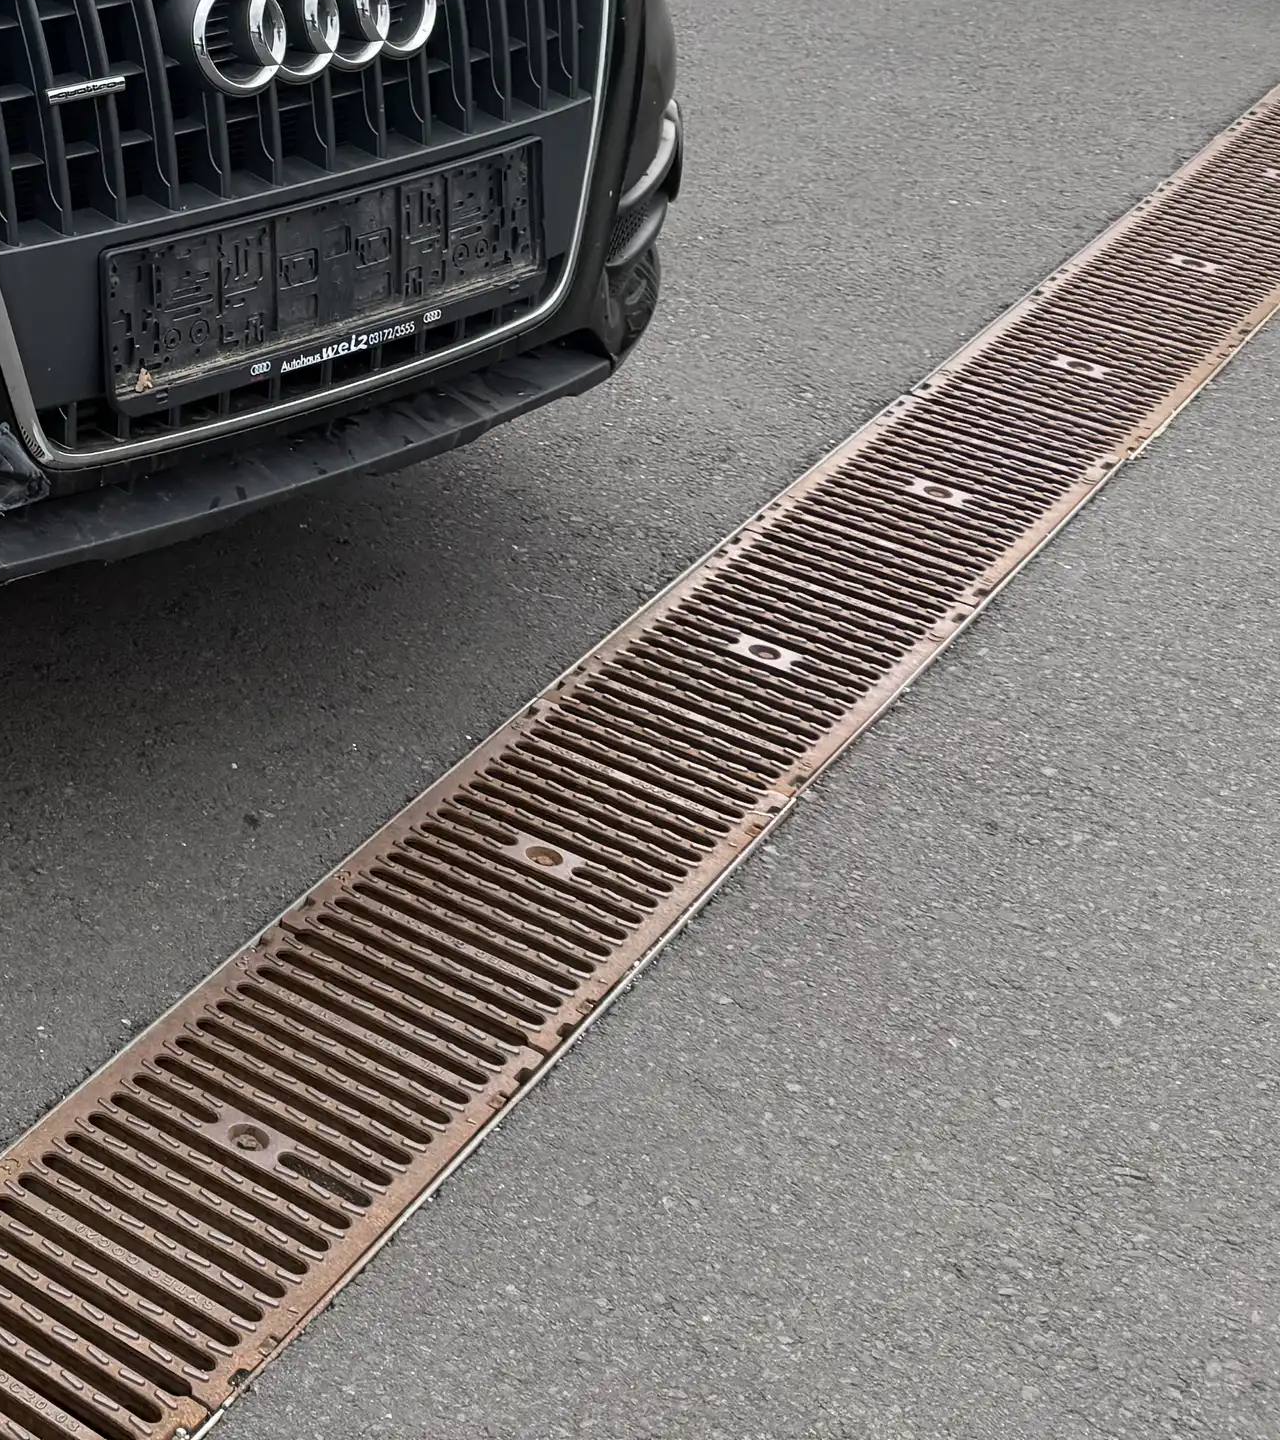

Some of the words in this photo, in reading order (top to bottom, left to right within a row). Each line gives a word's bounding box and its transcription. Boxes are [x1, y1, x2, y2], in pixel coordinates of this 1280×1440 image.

[57, 81, 117, 99] quattro
[281, 353, 321, 373] Autohaus
[369, 321, 415, 345] 03172/3555
[147, 1266, 216, 1311] SYTEC
